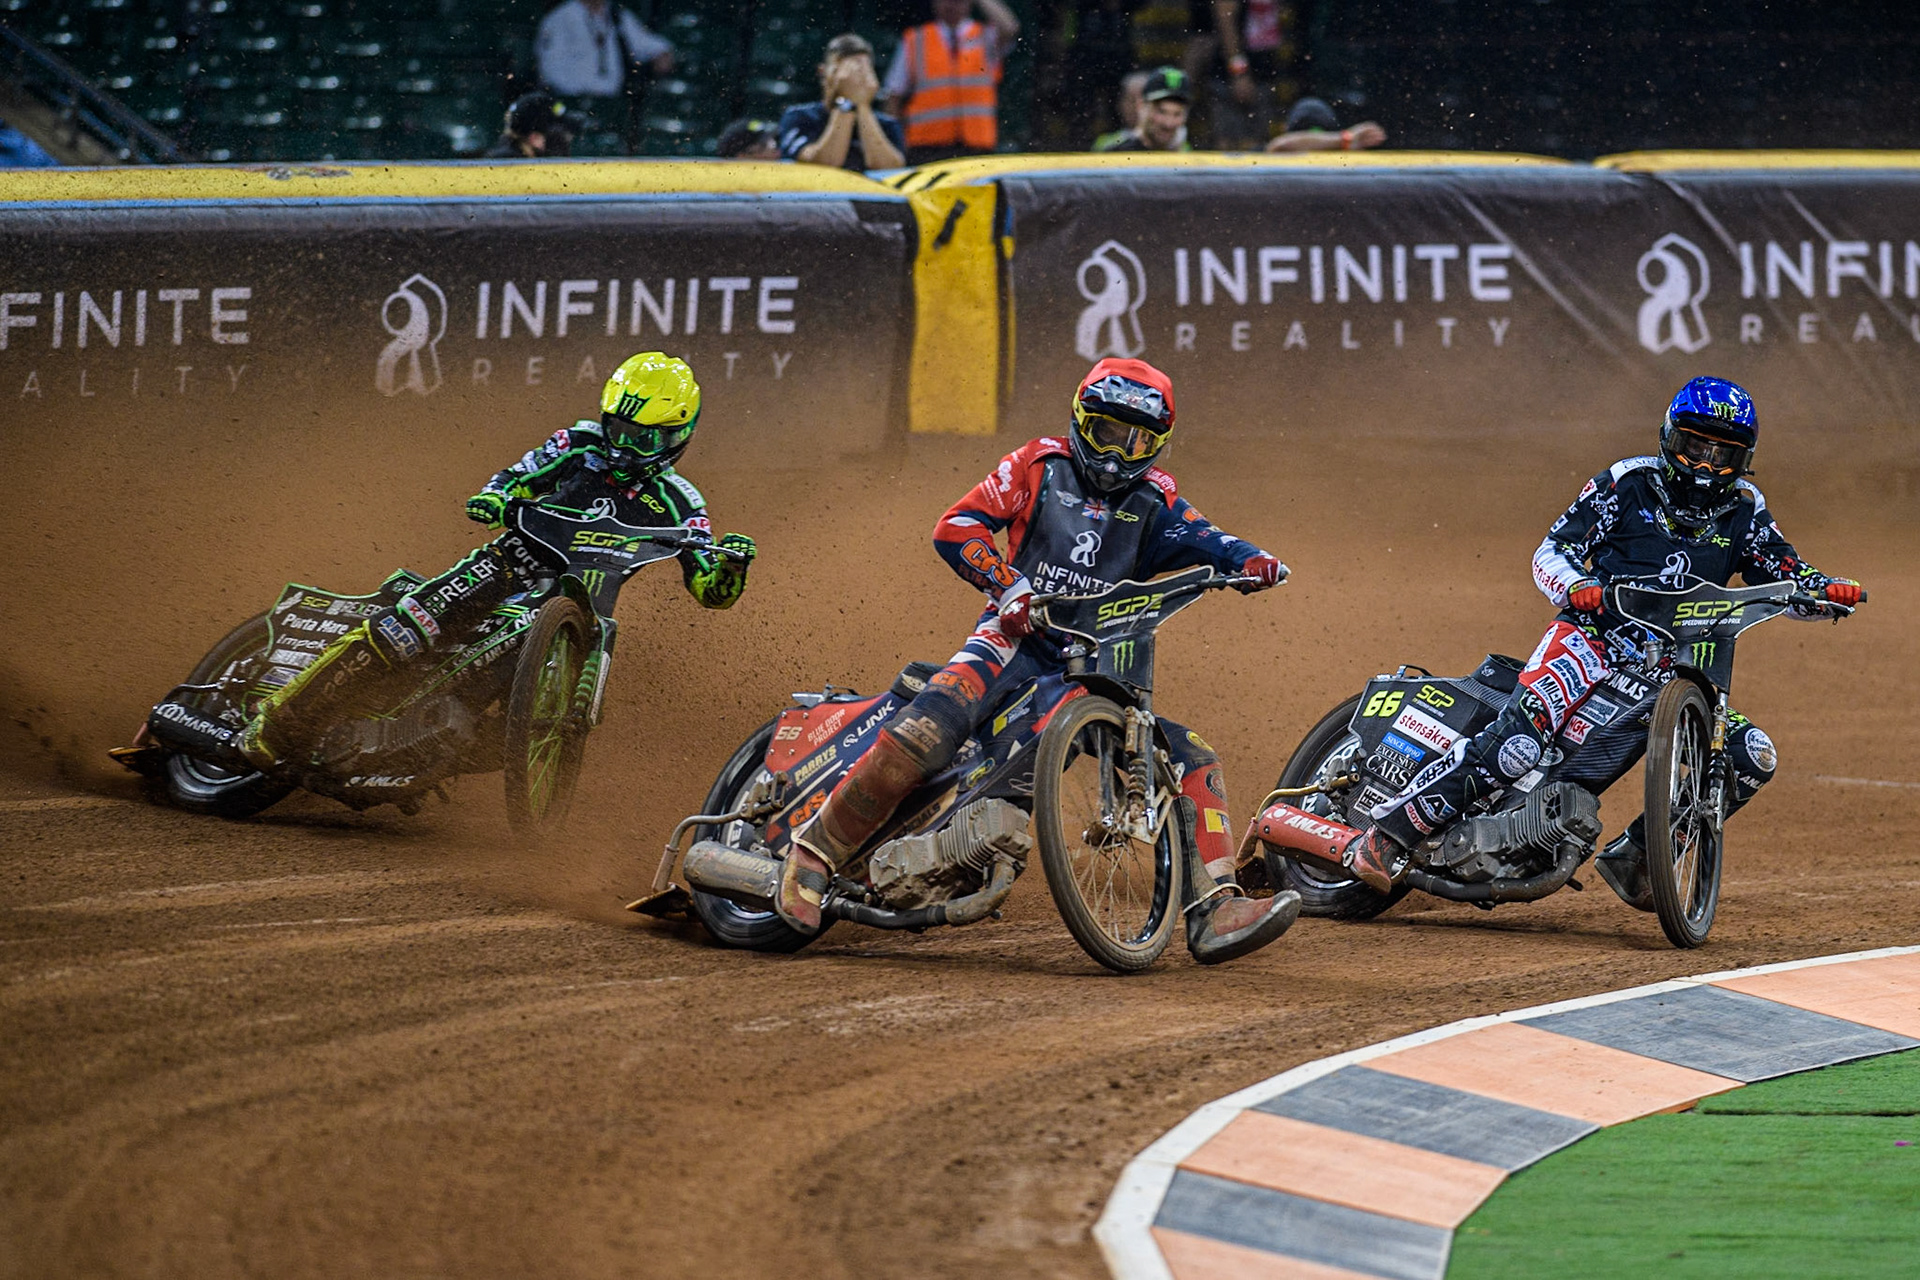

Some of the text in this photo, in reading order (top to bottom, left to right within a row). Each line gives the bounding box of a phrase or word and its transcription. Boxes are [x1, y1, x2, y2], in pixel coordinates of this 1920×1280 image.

[1176, 243, 1514, 303] INFINITE
[476, 277, 799, 339] INFINITE
[1176, 319, 1511, 352] REALITY
[1115, 510, 1140, 522] SGP
[281, 613, 349, 635] Porta Mare
[1415, 683, 1455, 708] SGP
[1606, 672, 1650, 701] ANLAS
[1362, 690, 1405, 718] 66
[807, 708, 847, 742] BLUE DOOR
[857, 700, 895, 737] LINK
[813, 719, 843, 747] PROJECT
[1385, 735, 1404, 751] SINCE
[1366, 754, 1412, 788] CARS
[1283, 814, 1340, 840] ANLAS
